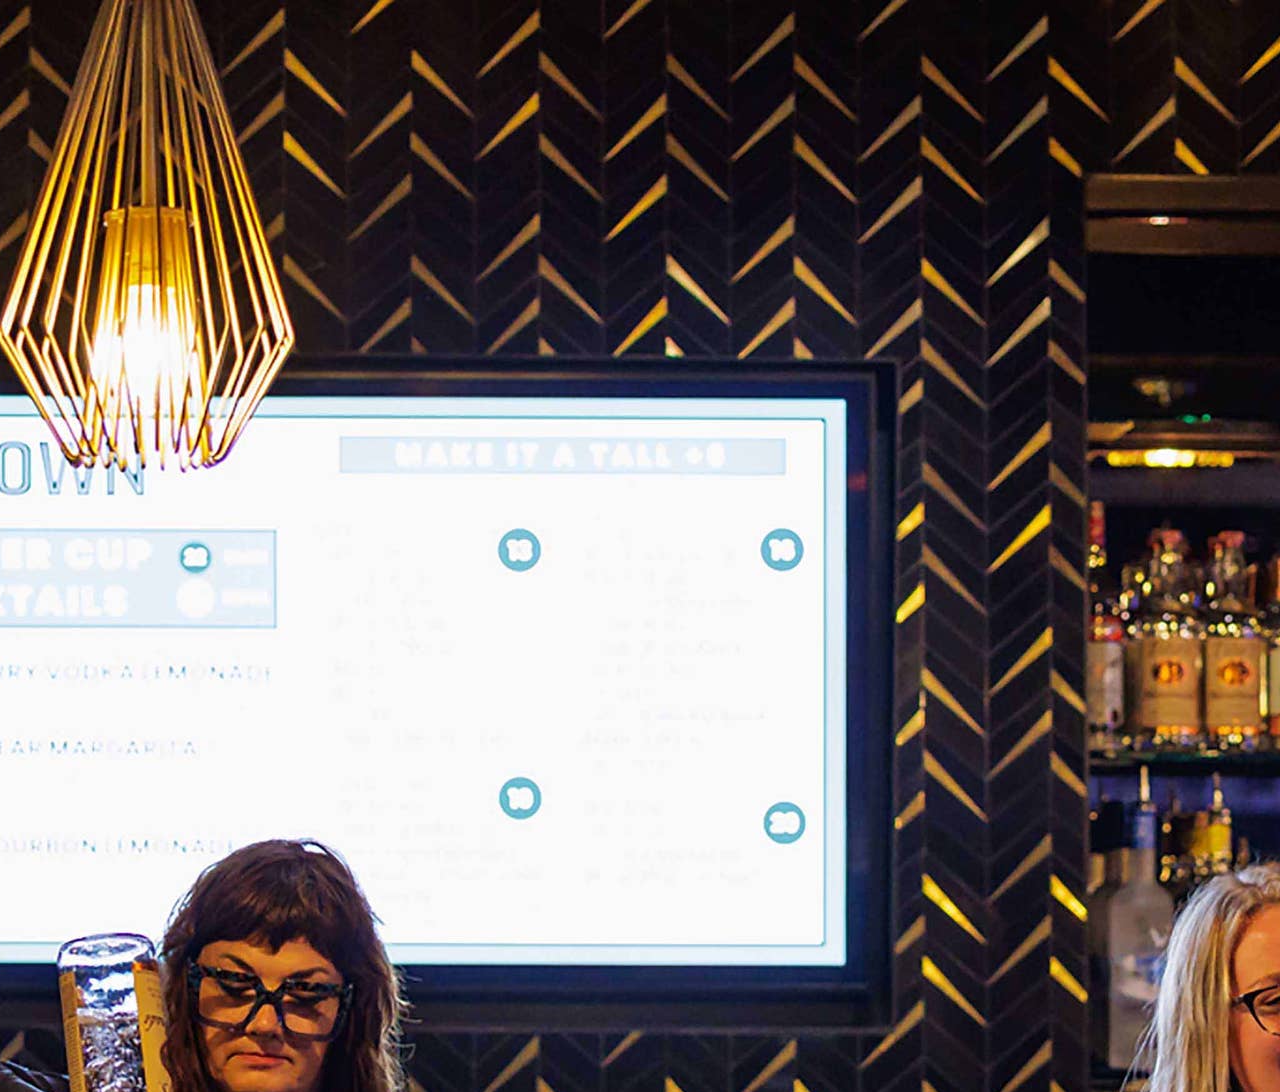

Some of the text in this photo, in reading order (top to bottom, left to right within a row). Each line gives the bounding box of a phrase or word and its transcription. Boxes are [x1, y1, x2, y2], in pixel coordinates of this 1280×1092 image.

[394, 440, 495, 469] MAKE
[505, 440, 540, 469] IT
[552, 440, 577, 469] A
[588, 440, 672, 469] TALL
[63, 536, 154, 572] CUP
